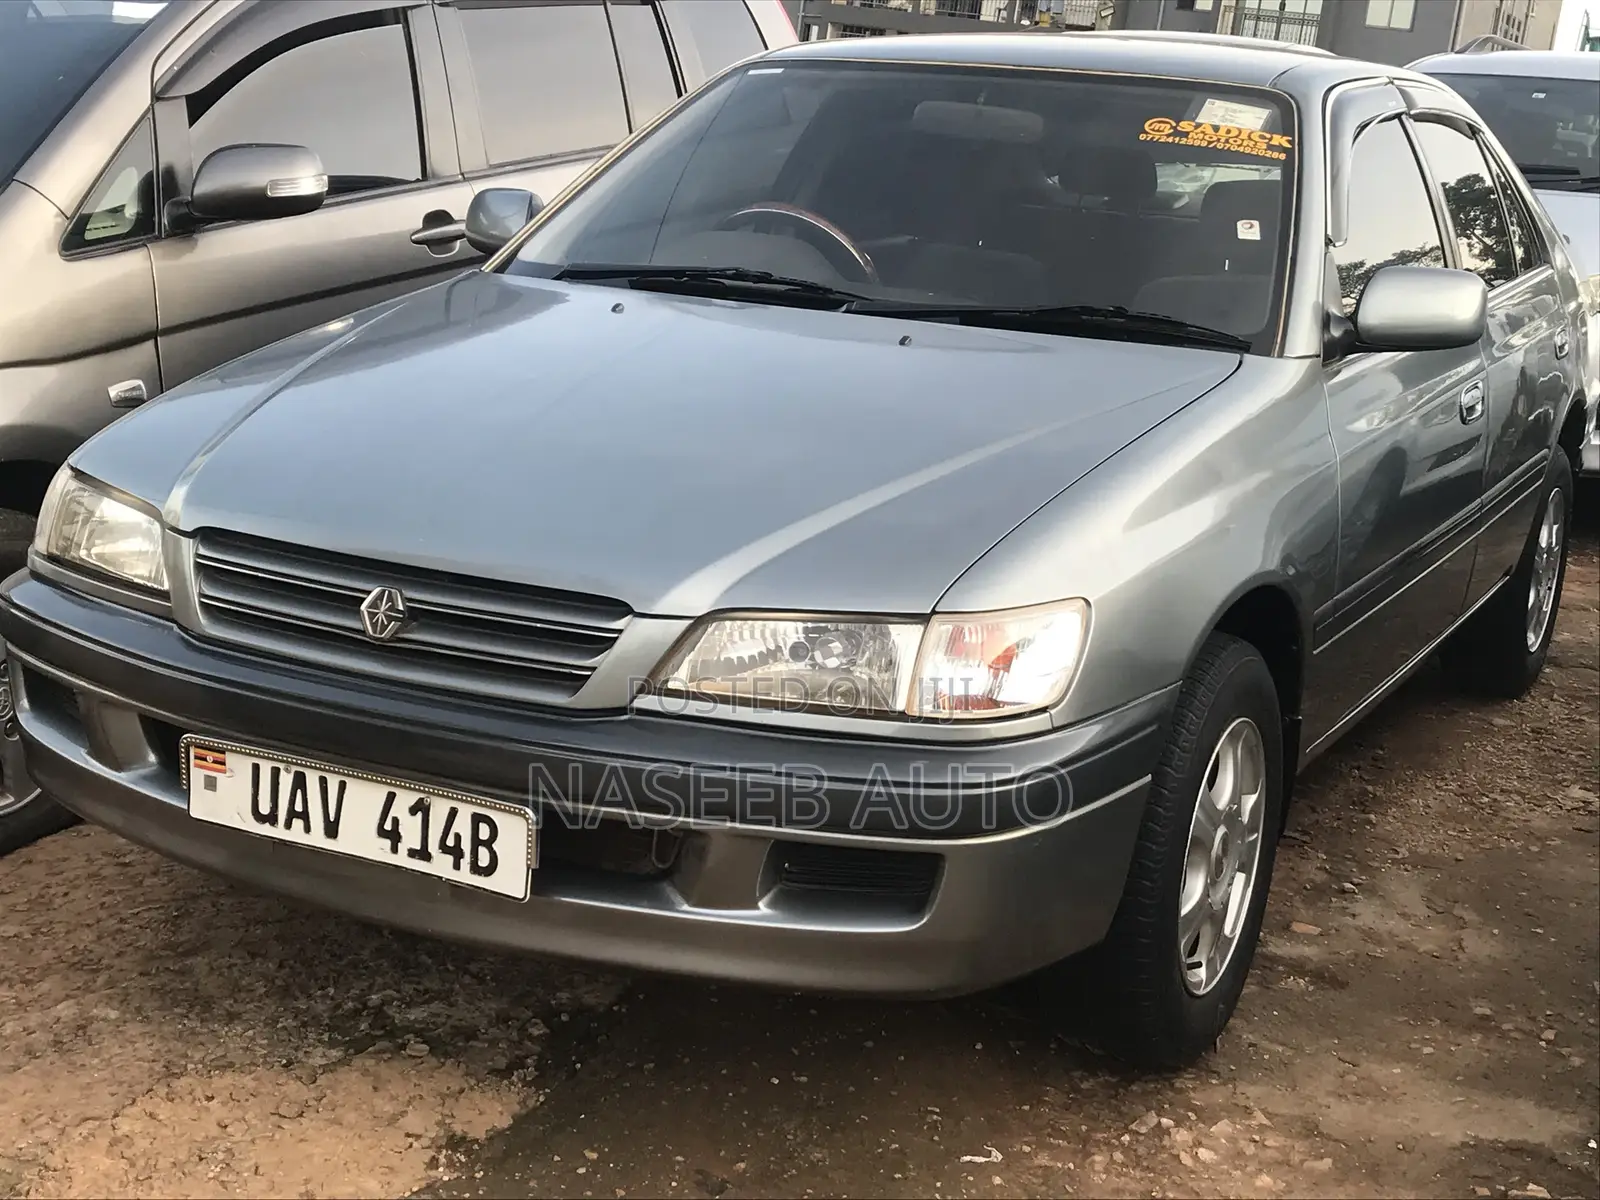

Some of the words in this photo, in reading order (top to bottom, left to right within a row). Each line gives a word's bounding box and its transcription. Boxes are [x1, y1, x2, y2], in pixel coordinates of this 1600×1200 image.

[1177, 120, 1292, 148] SADICK
[1188, 132, 1267, 149] MOTORS
[251, 762, 348, 840] UAV
[376, 791, 500, 878] 414B
